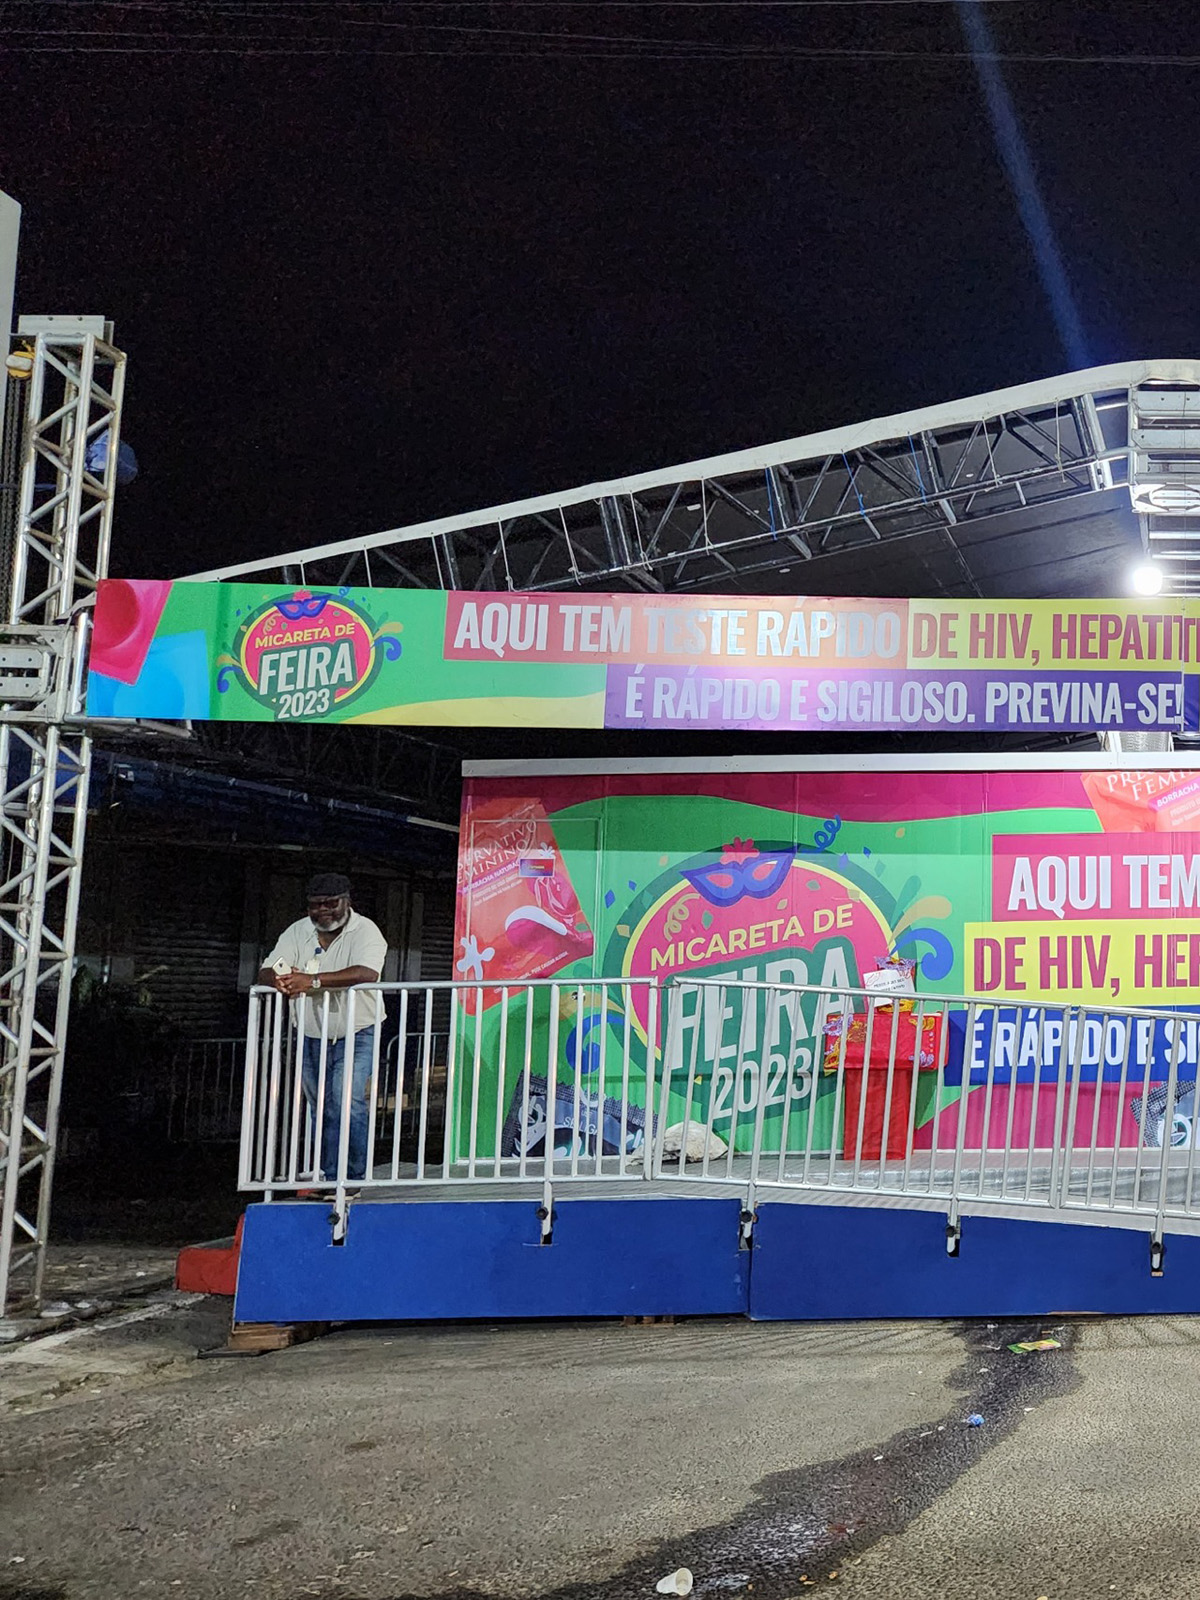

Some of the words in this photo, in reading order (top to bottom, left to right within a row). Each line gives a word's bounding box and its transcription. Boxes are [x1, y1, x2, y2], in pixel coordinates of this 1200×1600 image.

[255, 627, 331, 648] MICARETA
[335, 622, 355, 636] DE
[453, 601, 549, 658] AQUI
[559, 605, 630, 653] TEM
[643, 607, 748, 656] TESTE
[756, 595, 900, 658] RÁPIDO
[912, 613, 957, 659] DE
[969, 613, 1040, 666] HIV,
[259, 642, 354, 695] FEIRA
[625, 663, 646, 719] É
[653, 664, 779, 721] RÁPIDO
[789, 679, 809, 721] E
[816, 680, 976, 724] SIGILOSO.
[985, 681, 1183, 726] PREVINA-SE!
[278, 688, 330, 719] 2023
[1156, 783, 1200, 808] BORRACHA
[1007, 855, 1112, 919] AQUI
[650, 915, 805, 971] MICARETA
[813, 903, 854, 934] DE
[973, 937, 1026, 992] DE
[1038, 935, 1120, 997] HIV,
[671, 946, 856, 1070] FEIRA
[969, 1008, 985, 1068] É
[995, 1008, 1126, 1067] RÁPIDO
[1136, 1019, 1156, 1065] E
[712, 1047, 813, 1120] 2023
